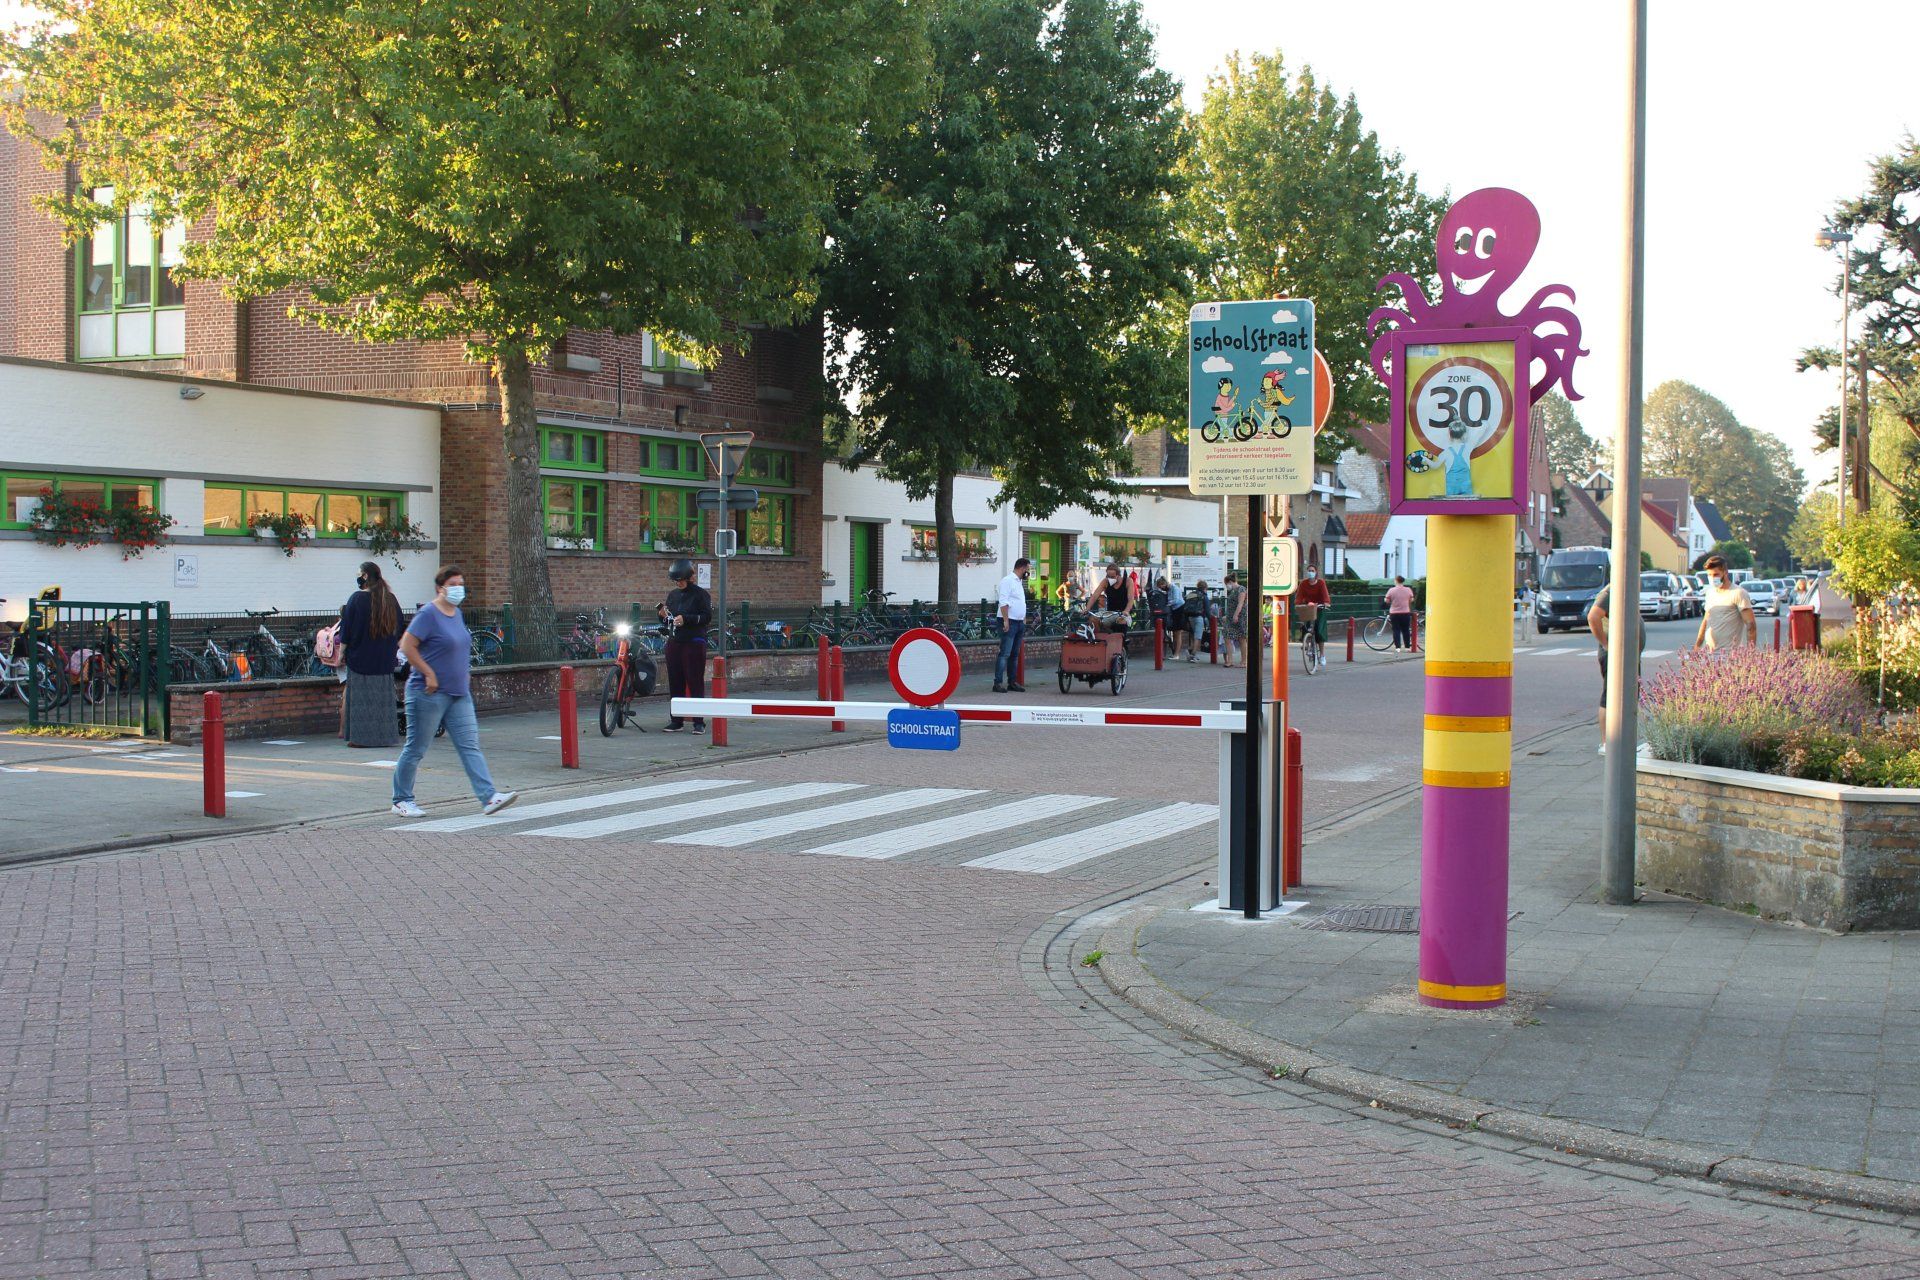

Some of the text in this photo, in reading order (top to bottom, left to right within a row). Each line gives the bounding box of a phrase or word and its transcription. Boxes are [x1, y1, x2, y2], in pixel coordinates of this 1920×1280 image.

[1447, 375, 1471, 383] ZONE
[1429, 385, 1491, 429] 30
[178, 558, 184, 572] P
[1269, 563, 1282, 573] 57
[890, 723, 956, 736] SCHOOLSTRAAT
